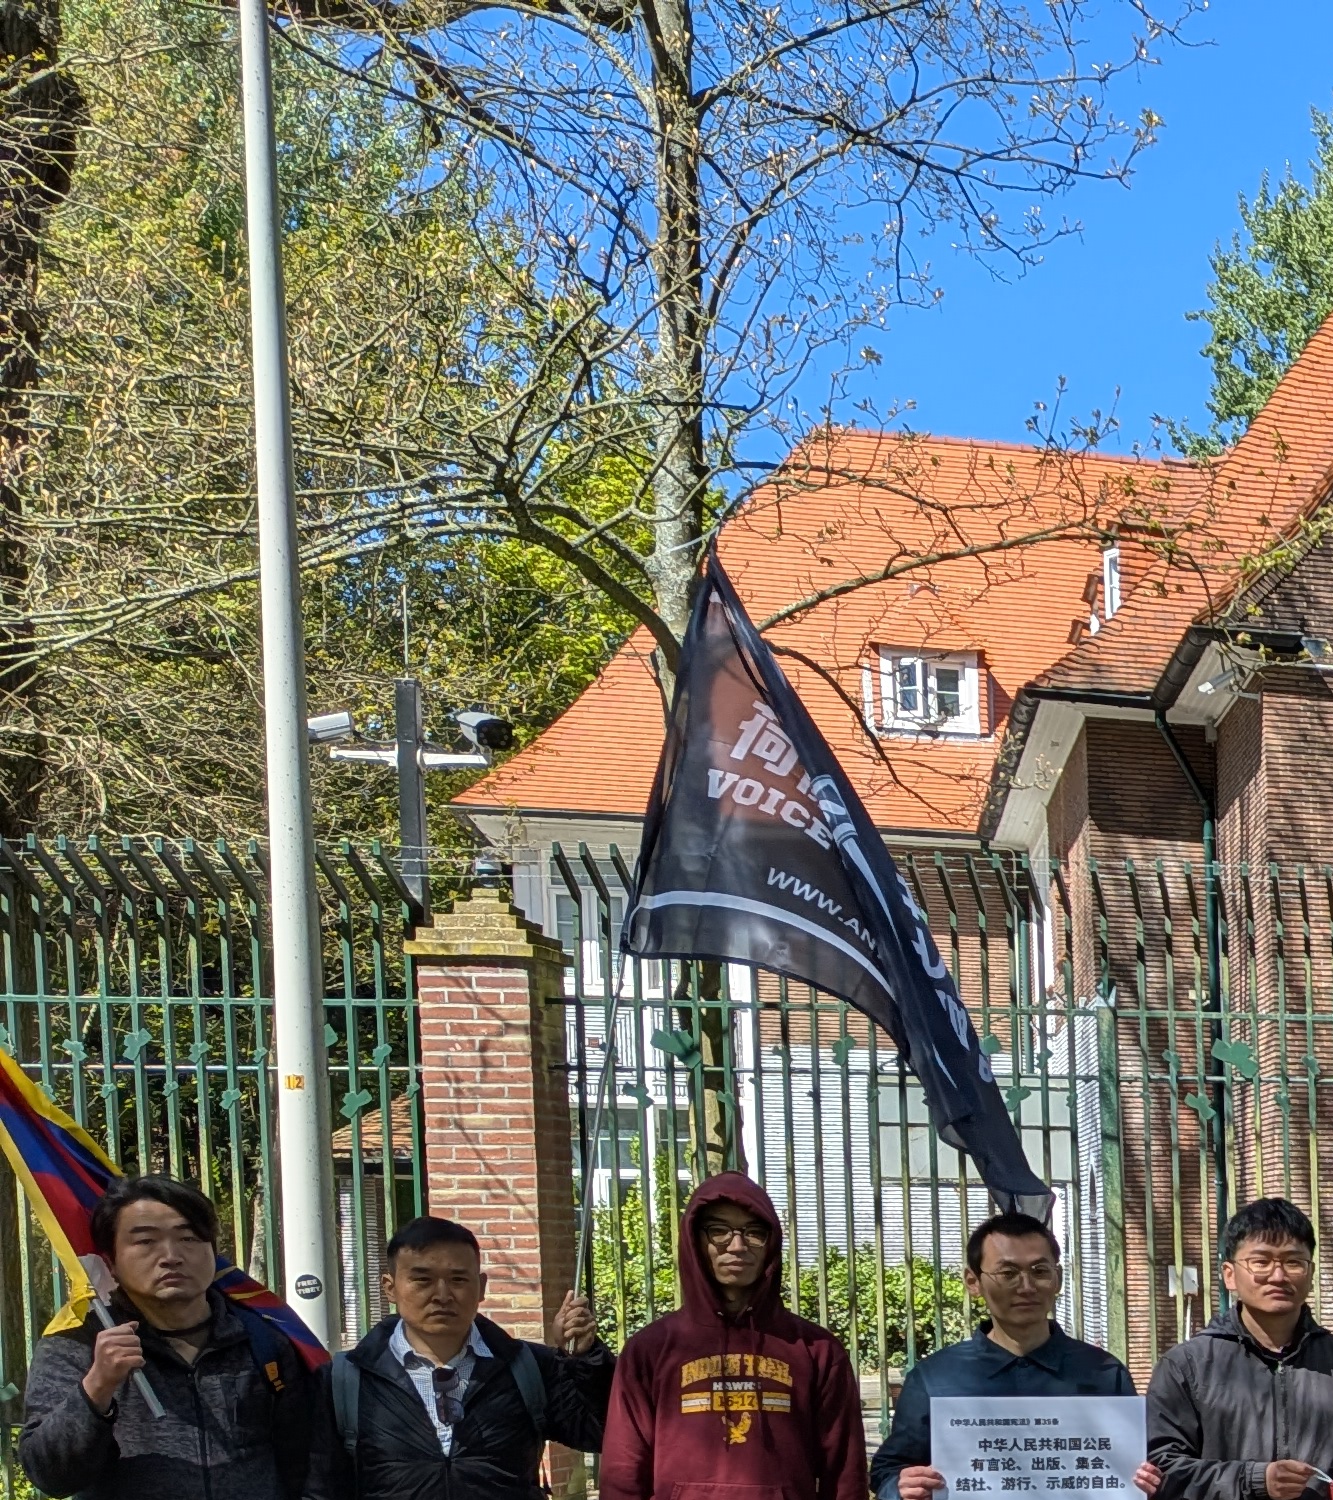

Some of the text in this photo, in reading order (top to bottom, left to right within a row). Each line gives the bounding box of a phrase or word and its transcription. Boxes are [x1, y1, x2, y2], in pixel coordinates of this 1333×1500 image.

[707, 768, 833, 850] VOICE
[767, 867, 879, 957] WWW.AN
[297, 1278, 318, 1288] FREE
[978, 1437, 1112, 1452] 中华人民共和国公民
[970, 1456, 1111, 1472] 有言论、出版、集会、
[955, 1475, 1127, 1492] 结社、游行、示威的自由。
